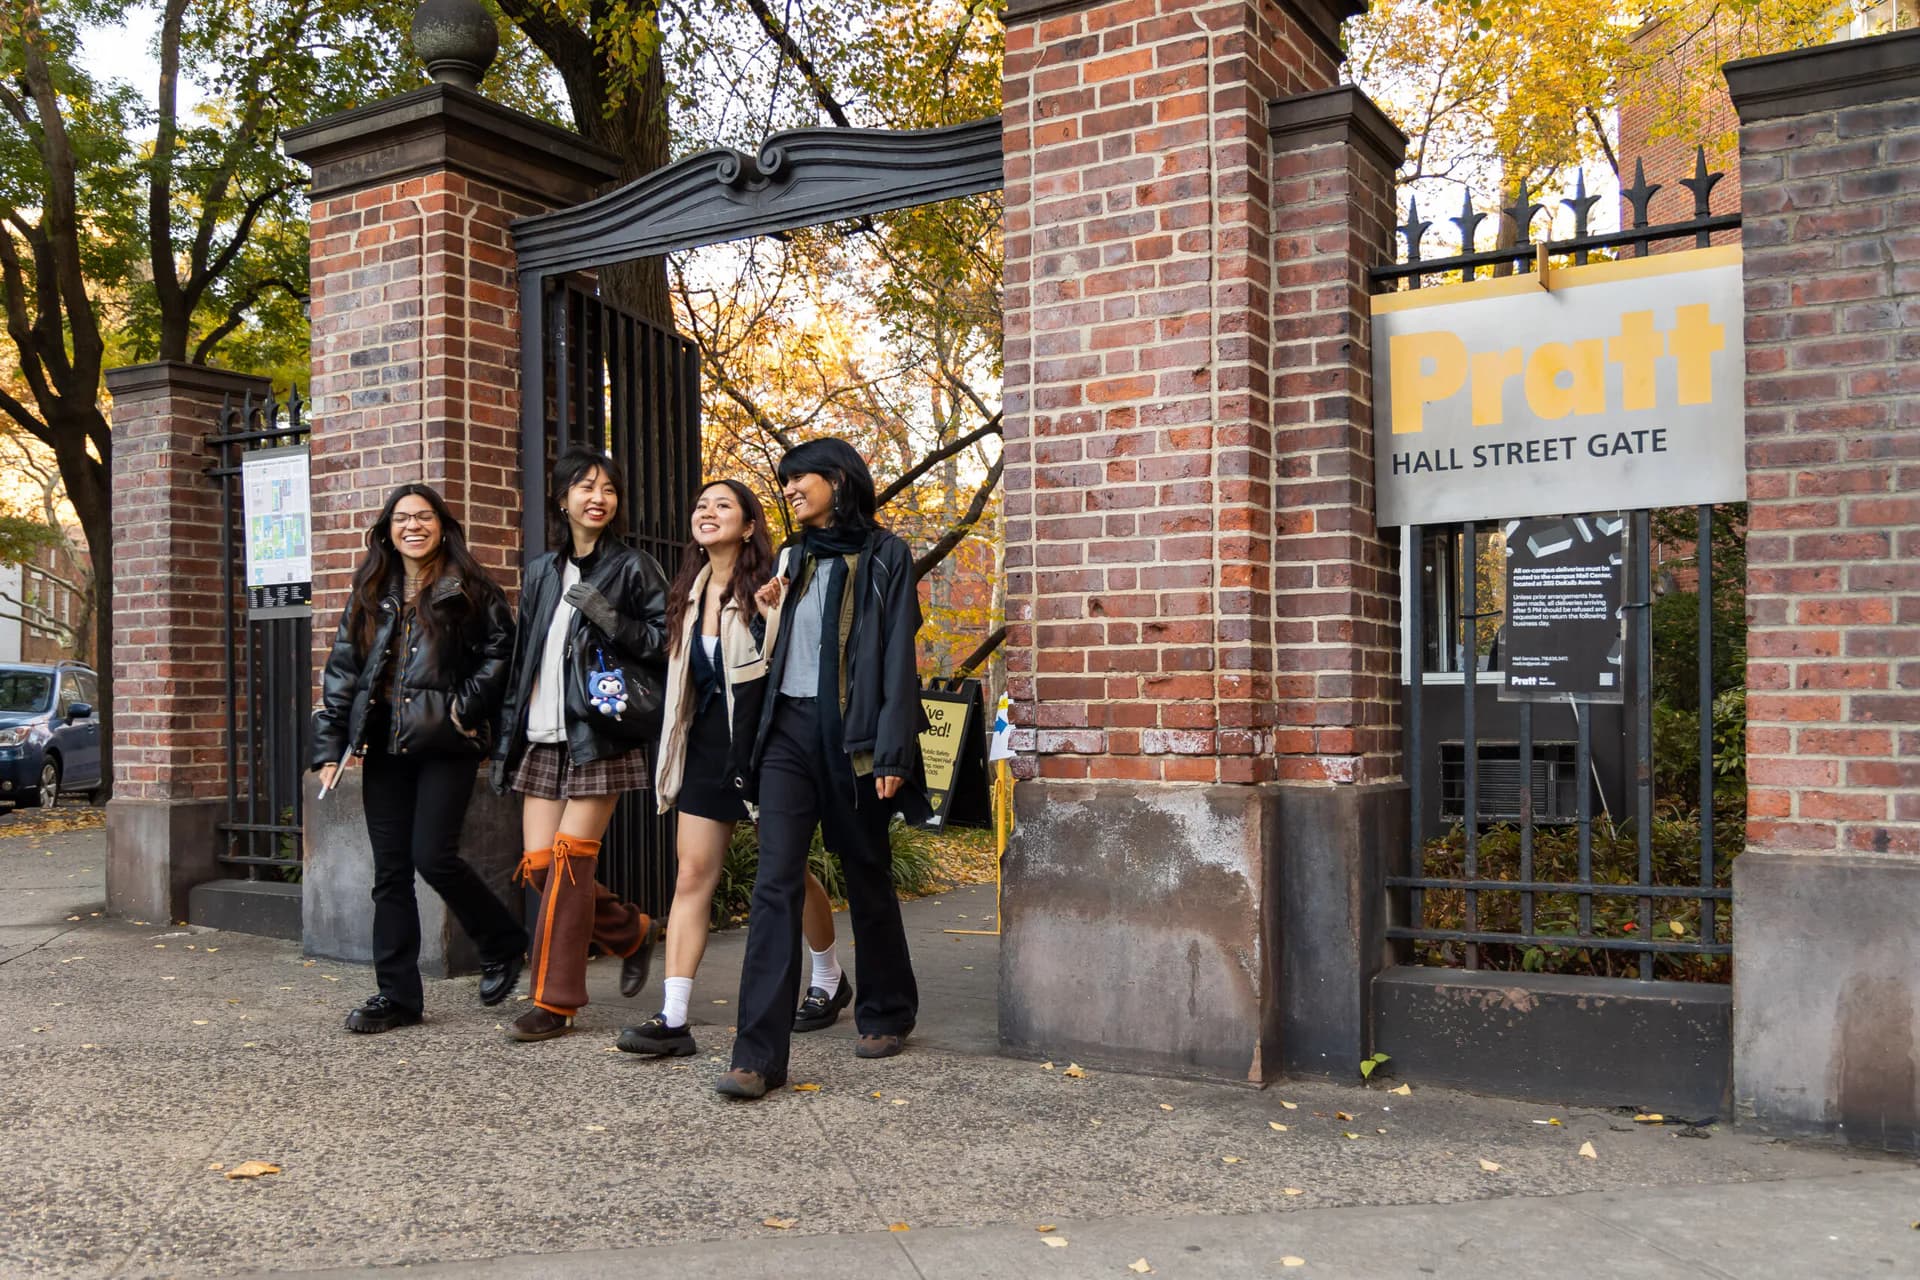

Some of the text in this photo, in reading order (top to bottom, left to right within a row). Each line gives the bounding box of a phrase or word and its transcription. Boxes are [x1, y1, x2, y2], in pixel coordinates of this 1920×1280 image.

[1389, 303, 1725, 435] Pratt
[1392, 428, 1668, 475] HALL STREET GATE
[1512, 676, 1536, 686] Pratt
[926, 704, 944, 721] 've
[924, 722, 951, 738] ed!
